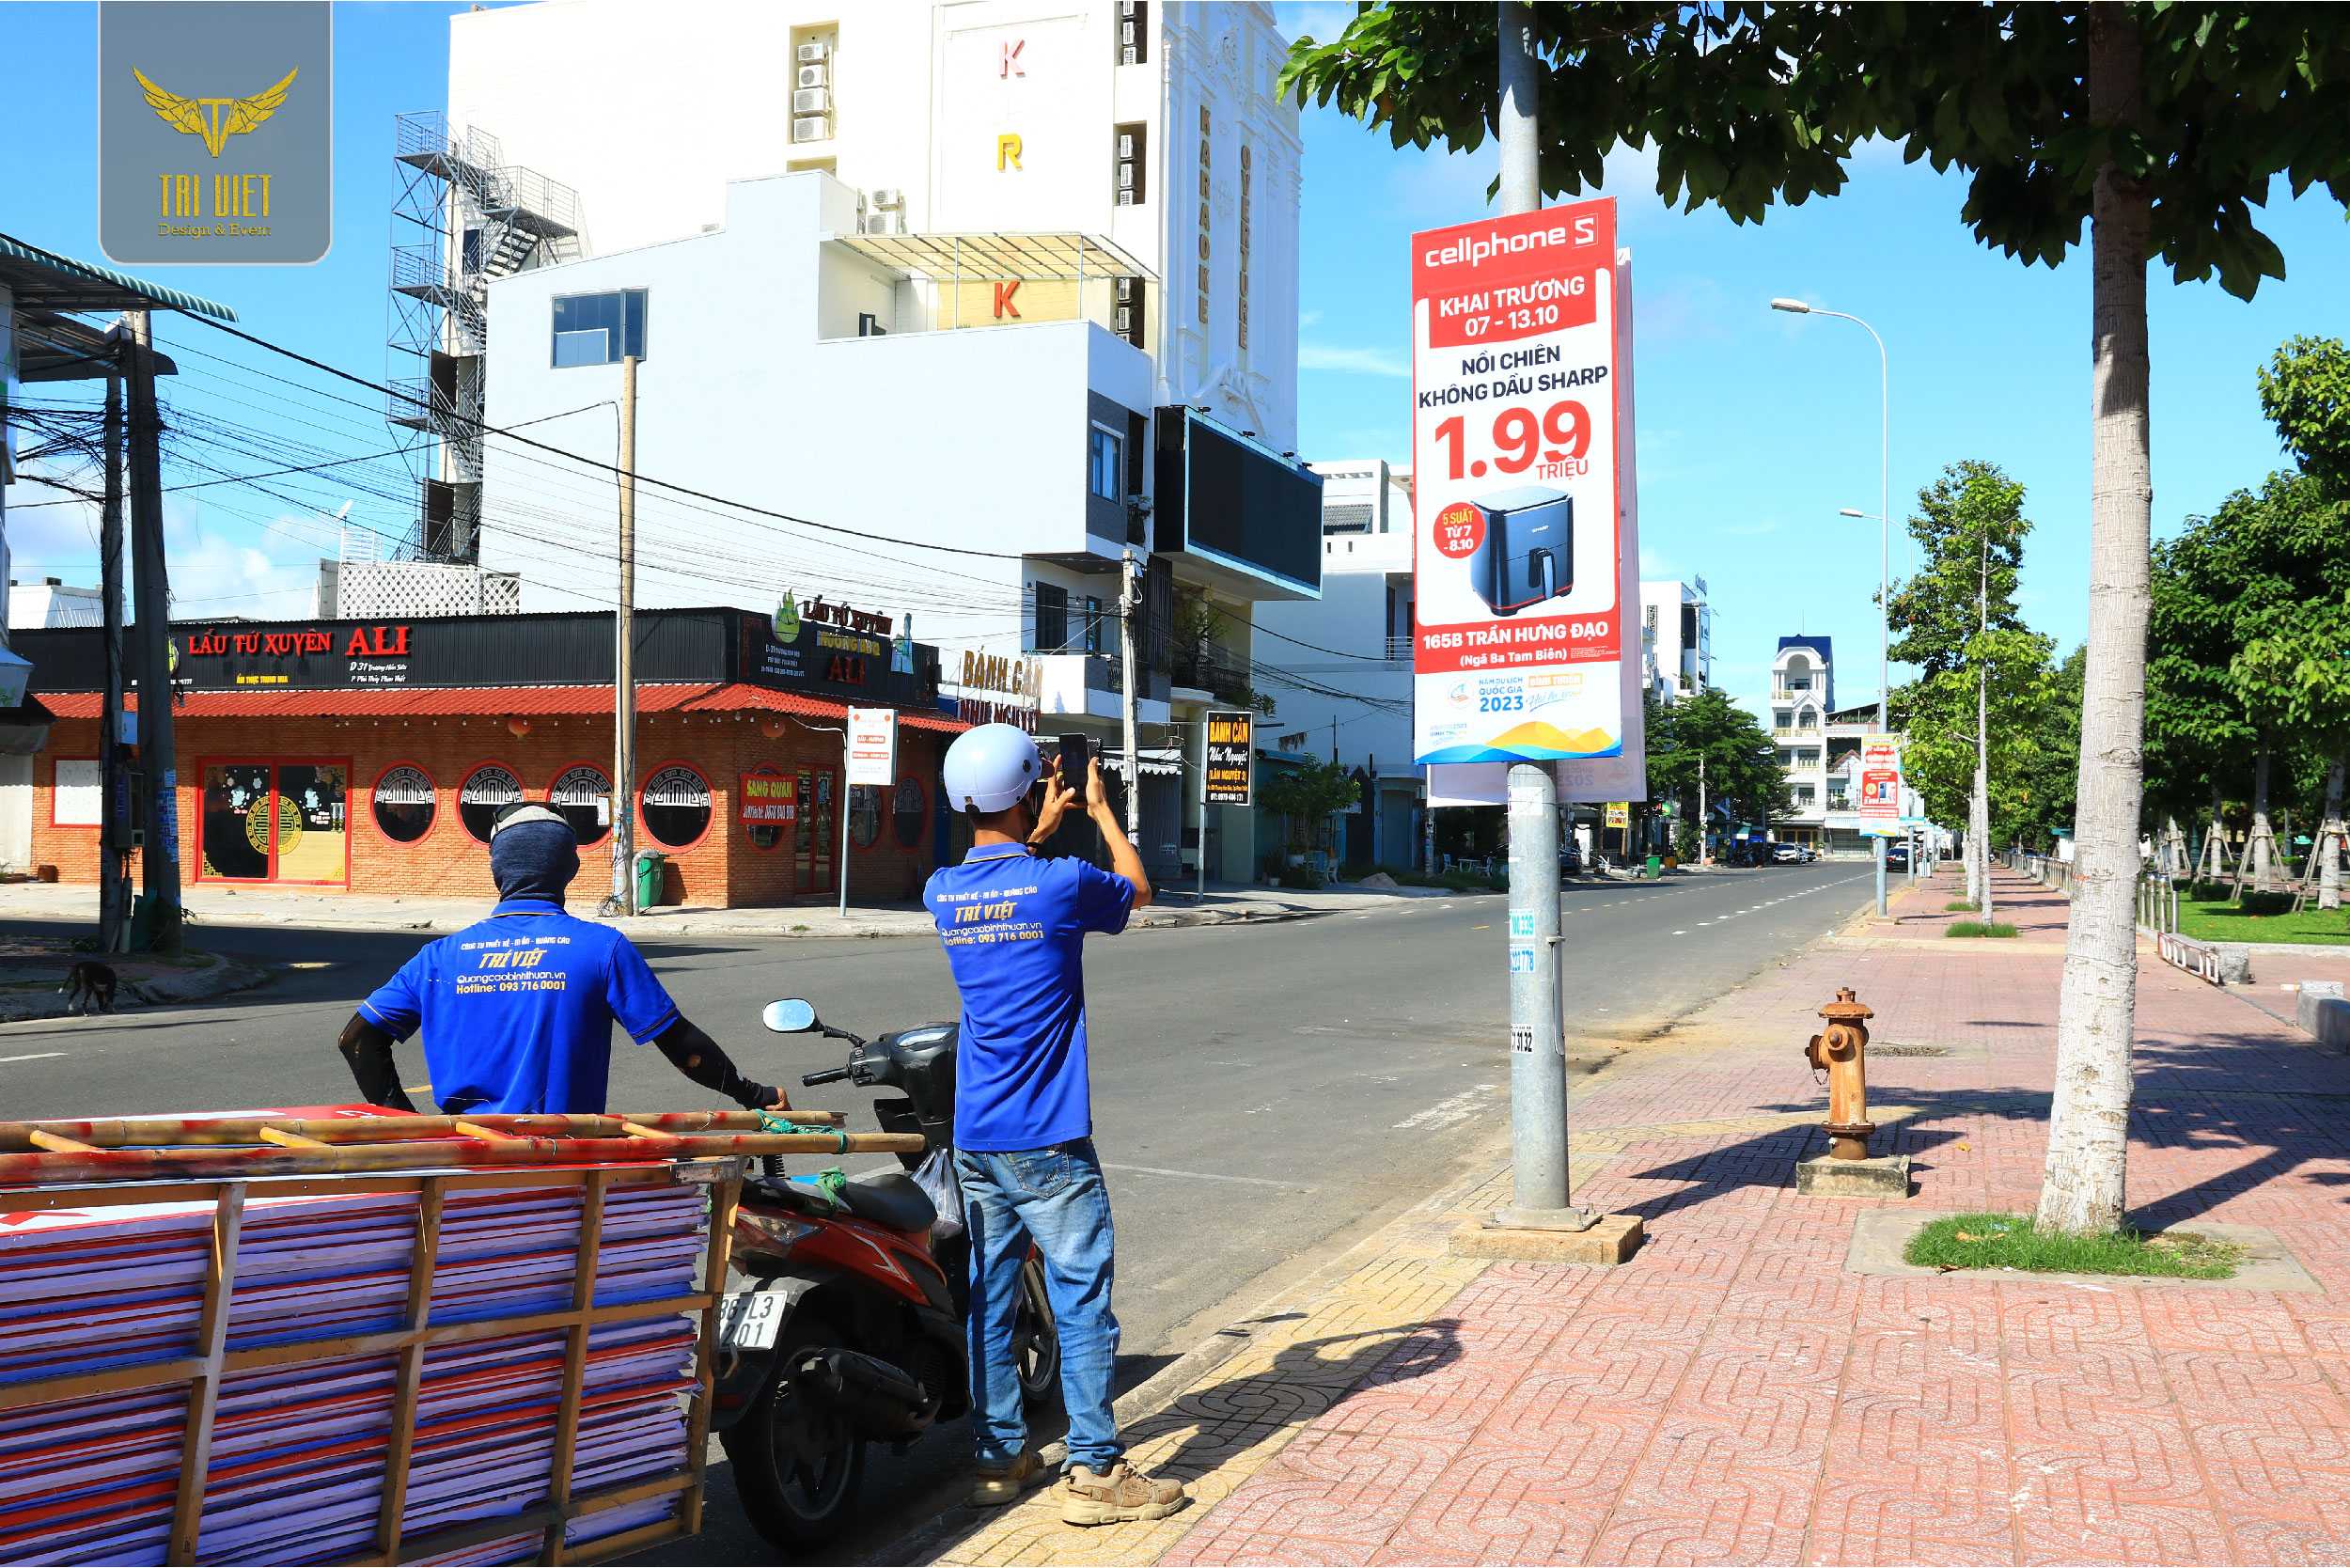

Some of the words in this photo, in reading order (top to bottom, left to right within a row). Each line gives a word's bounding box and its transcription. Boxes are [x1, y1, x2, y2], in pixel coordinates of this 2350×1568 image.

[997, 133, 1023, 173] R
[1198, 104, 1211, 324] KARAOKE
[1238, 144, 1251, 351] OVERTURE
[994, 279, 1021, 320] K
[1439, 292, 1489, 318] KHAI
[1494, 275, 1586, 309] TRƯƠNG
[1465, 316, 1490, 337] 07
[1508, 305, 1559, 330] 13.10
[1462, 350, 1495, 376] NỒI
[1499, 343, 1560, 371] CHIÊN
[1418, 384, 1488, 409] KHÔNG
[1493, 372, 1533, 399] DẦU
[1538, 365, 1608, 392] SHARP
[1434, 400, 1591, 480] 1.99
[1535, 455, 1589, 481] TRIỆU
[1443, 512, 1449, 525] 5
[1445, 525, 1462, 539] Từ
[1464, 525, 1472, 537] 7
[1449, 538, 1474, 552] 8.10
[234, 630, 260, 653] TỨ
[264, 628, 332, 657] XUYÊN
[345, 626, 410, 656] ALI
[1423, 633, 1463, 650] 165B
[1465, 624, 1512, 647] TRẦN
[1514, 623, 1567, 643] HƯNG
[1570, 620, 1608, 641] ĐẠO
[827, 655, 866, 684] ALI
[963, 645, 1008, 692] BÁNH
[1459, 653, 1488, 667] (Ngã
[1490, 651, 1504, 664] Ba
[1508, 651, 1533, 663] Tam
[1535, 647, 1567, 662] Biên)
[1480, 696, 1524, 713] 2023
[1209, 715, 1231, 743] BÁNH
[746, 779, 768, 797] SANG
[984, 900, 1018, 921] VIỆT
[978, 933, 995, 944] 093
[998, 933, 1016, 942] 716
[1019, 931, 1044, 939] 0001
[511, 948, 547, 969] VIỆT
[456, 971, 566, 984] Quangcaobinhthuan.vn
[456, 983, 496, 995] Hotline:
[499, 982, 519, 992] 093
[521, 981, 539, 991] 716
[540, 980, 566, 991] 0001
